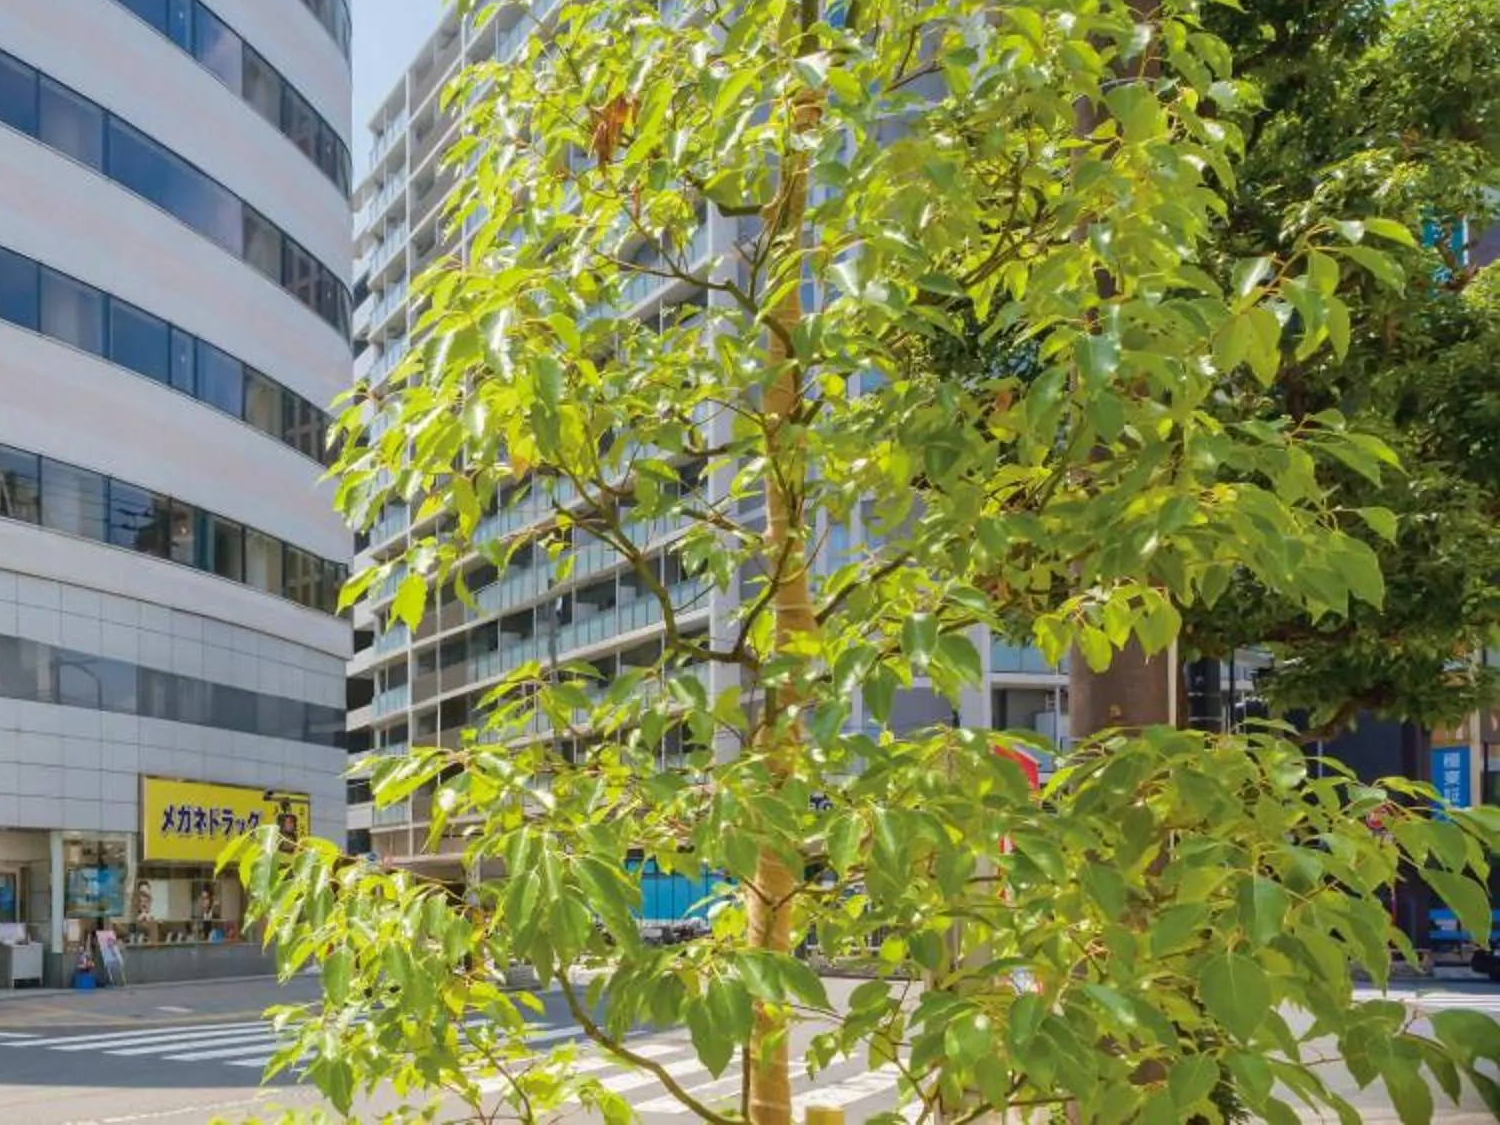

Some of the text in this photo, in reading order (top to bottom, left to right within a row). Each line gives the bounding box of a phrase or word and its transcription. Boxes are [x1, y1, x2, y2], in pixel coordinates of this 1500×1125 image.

[161, 803, 263, 836] メガネドラッグ
